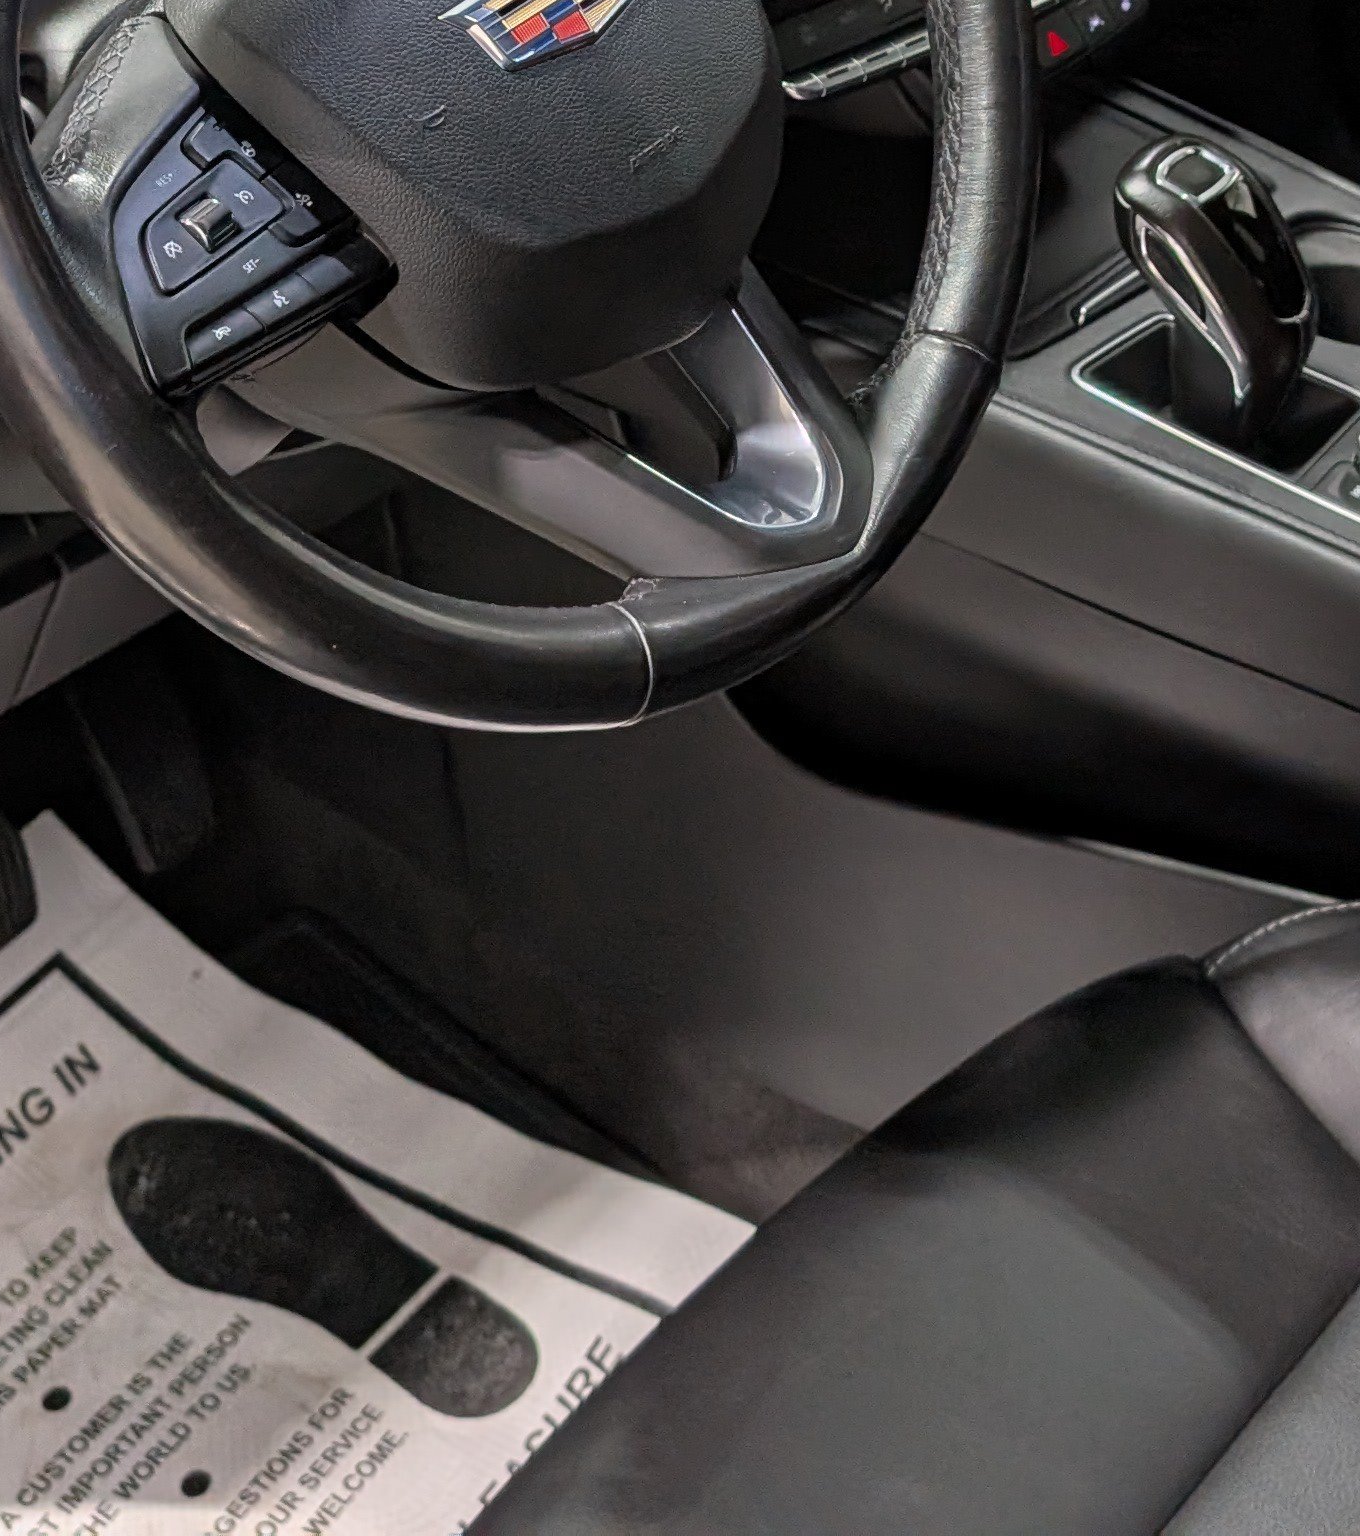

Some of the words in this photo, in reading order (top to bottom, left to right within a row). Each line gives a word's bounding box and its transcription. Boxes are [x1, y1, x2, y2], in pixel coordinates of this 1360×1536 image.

[53, 1042, 102, 1096] IN
[25, 1226, 78, 1281] KEEP
[44, 1240, 114, 1307] CLEAN
[11, 1318, 85, 1384] PAPER
[77, 1273, 123, 1318] MAT
[0, 1511, 22, 1531] A
[16, 1394, 131, 1507] CUSTOMER
[125, 1372, 154, 1396] IS
[145, 1331, 189, 1371] THE
[55, 1395, 172, 1514] IMPORTANT
[167, 1313, 252, 1397] PERSON
[112, 1421, 193, 1501] WORLD
[185, 1392, 222, 1422] TO
[298, 1403, 384, 1491] SERVICE
[307, 1386, 355, 1432] FOR
[302, 1429, 410, 1536] WELCOME.
